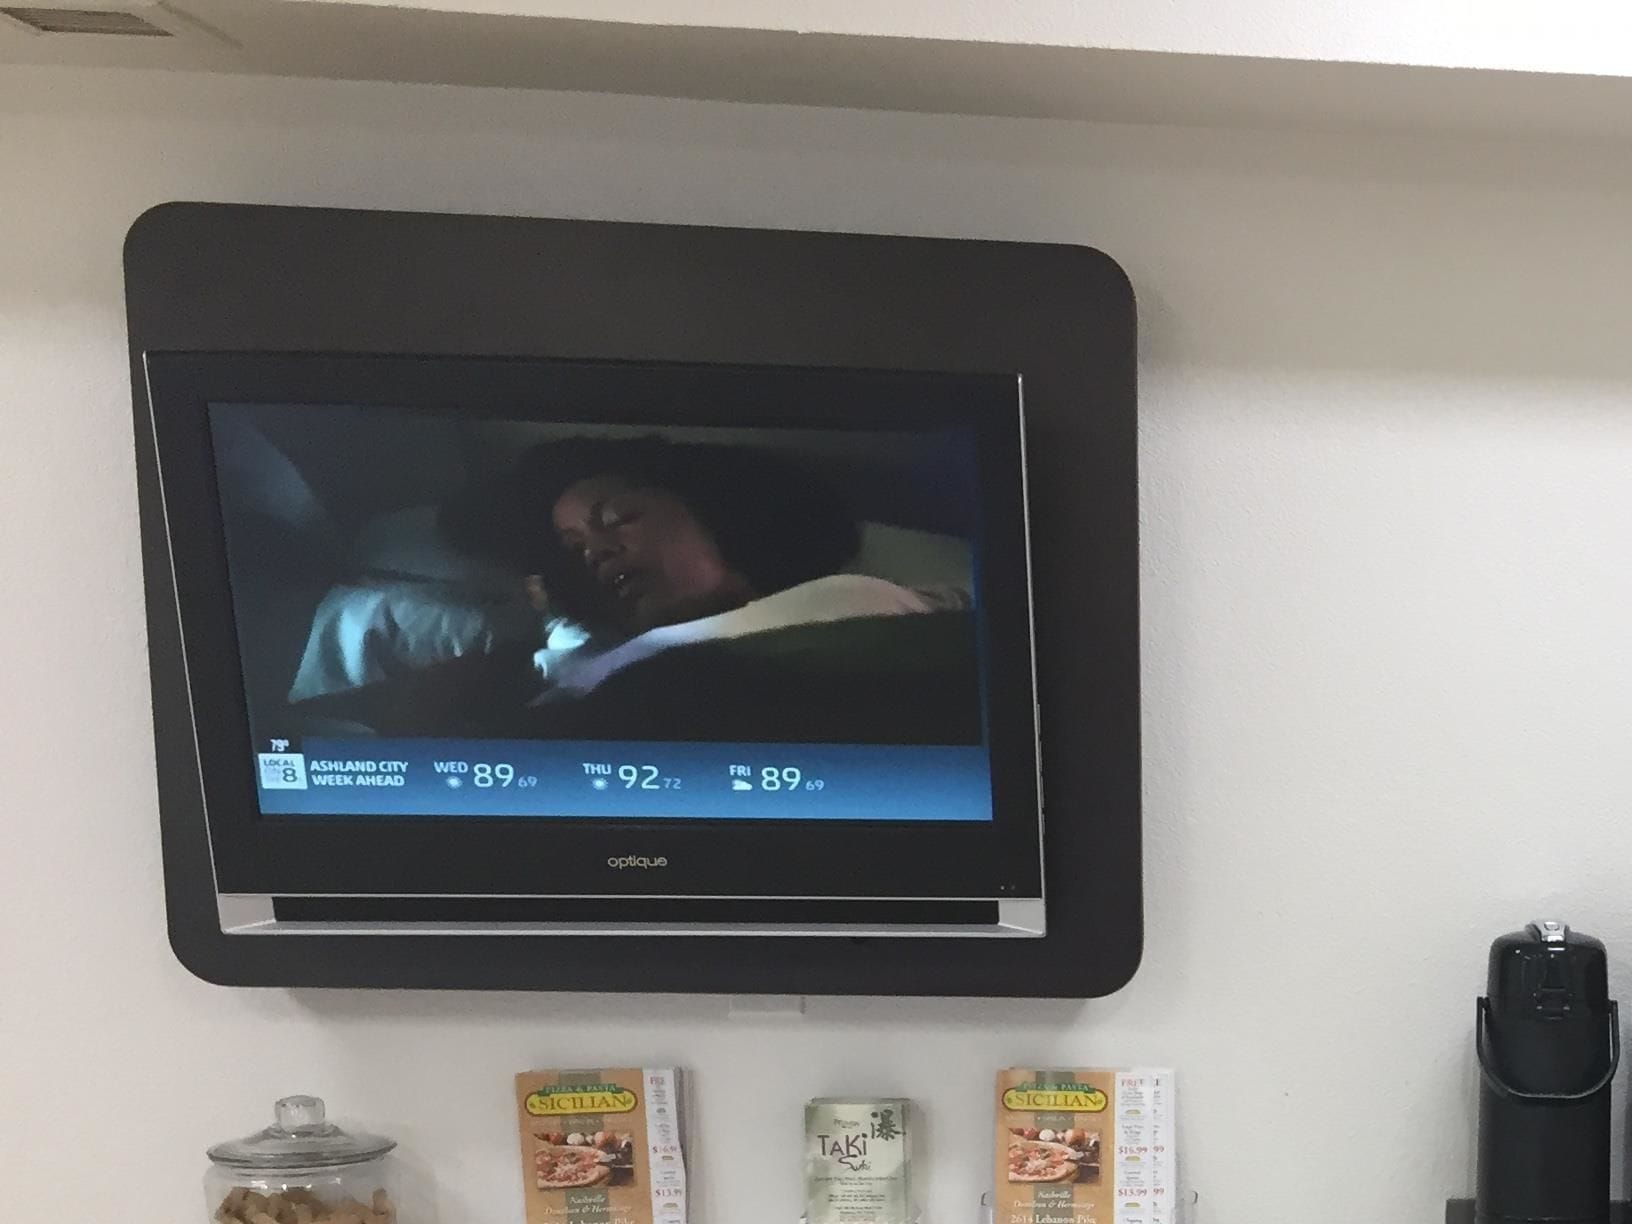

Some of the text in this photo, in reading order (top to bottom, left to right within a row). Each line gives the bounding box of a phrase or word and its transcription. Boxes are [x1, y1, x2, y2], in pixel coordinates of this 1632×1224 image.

[263, 759, 296, 768] LOCAL
[310, 760, 409, 773] ASHLAND CITY
[434, 761, 469, 773] WED
[582, 763, 612, 775] THU
[282, 767, 298, 782] 8
[473, 763, 538, 788] 89 69
[618, 765, 682, 789] 92 72
[729, 765, 752, 776] FRI
[311, 774, 406, 787] WEEK AHEAD
[761, 767, 825, 792] 89 69
[607, 856, 668, 870] optique
[538, 1093, 628, 1111] SICILIAN
[1015, 1093, 1099, 1108] SICILIAN
[1035, 1214, 1075, 1224] Lebanon
